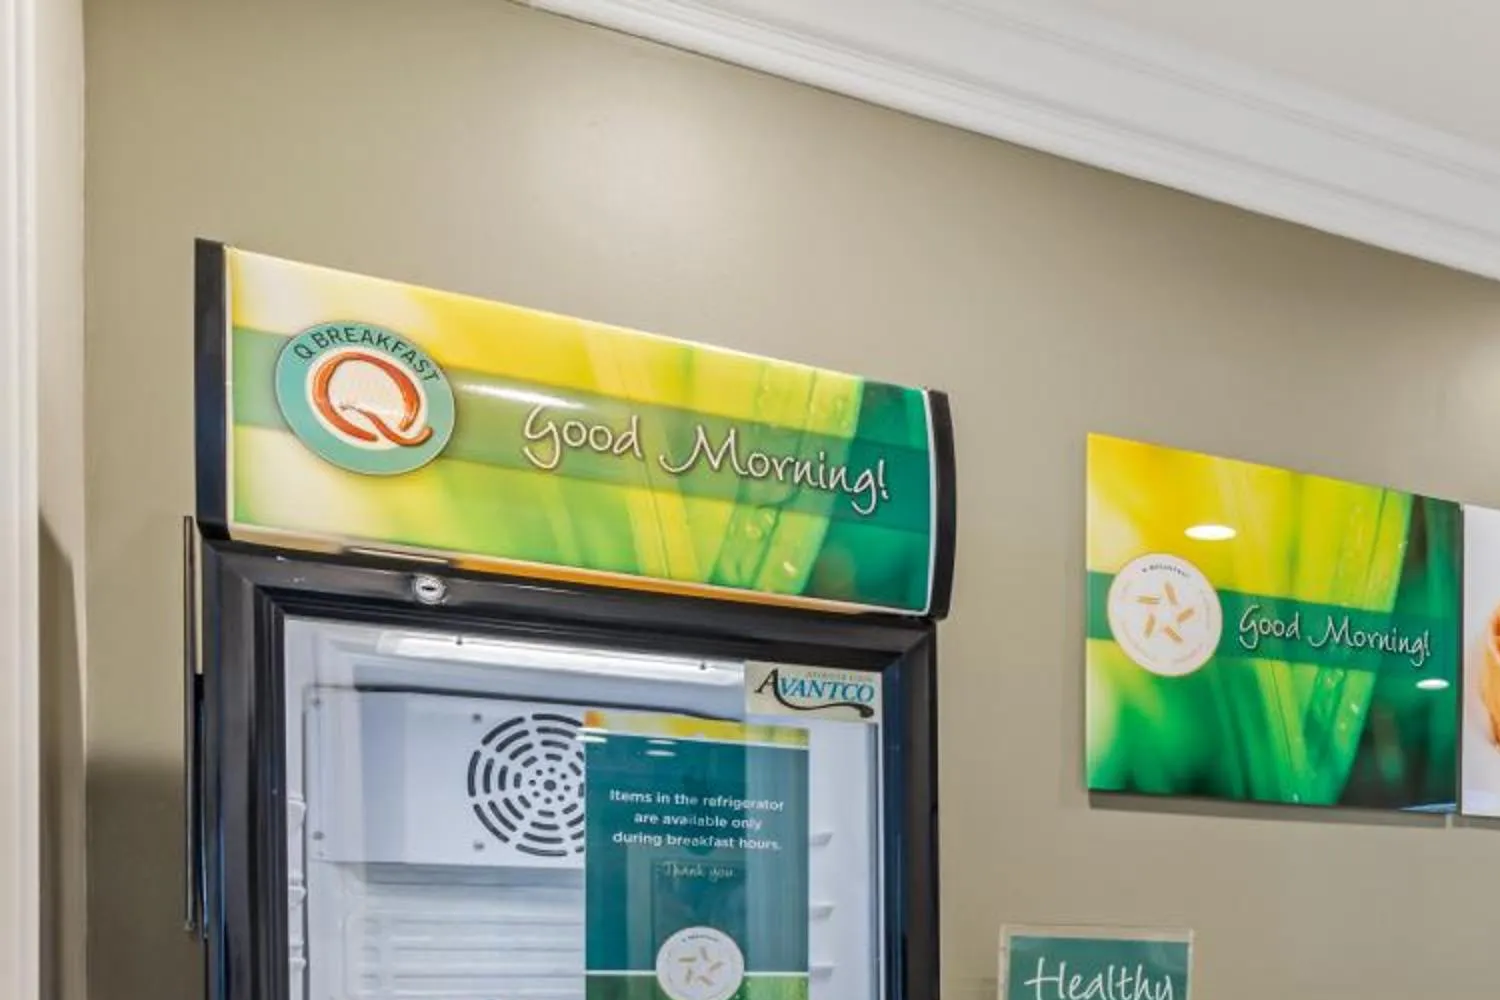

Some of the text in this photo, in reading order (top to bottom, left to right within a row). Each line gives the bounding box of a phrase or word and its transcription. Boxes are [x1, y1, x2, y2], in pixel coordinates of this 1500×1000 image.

[293, 326, 441, 383] Q BREAKFAST
[523, 402, 890, 516] Good Morning!
[1239, 604, 1432, 668] Good Morning!
[753, 667, 876, 718] AVANTCO
[609, 788, 785, 813] Items in the refrigerator
[634, 812, 763, 832] are available only
[612, 831, 663, 847] during
[665, 833, 735, 849] breakfast
